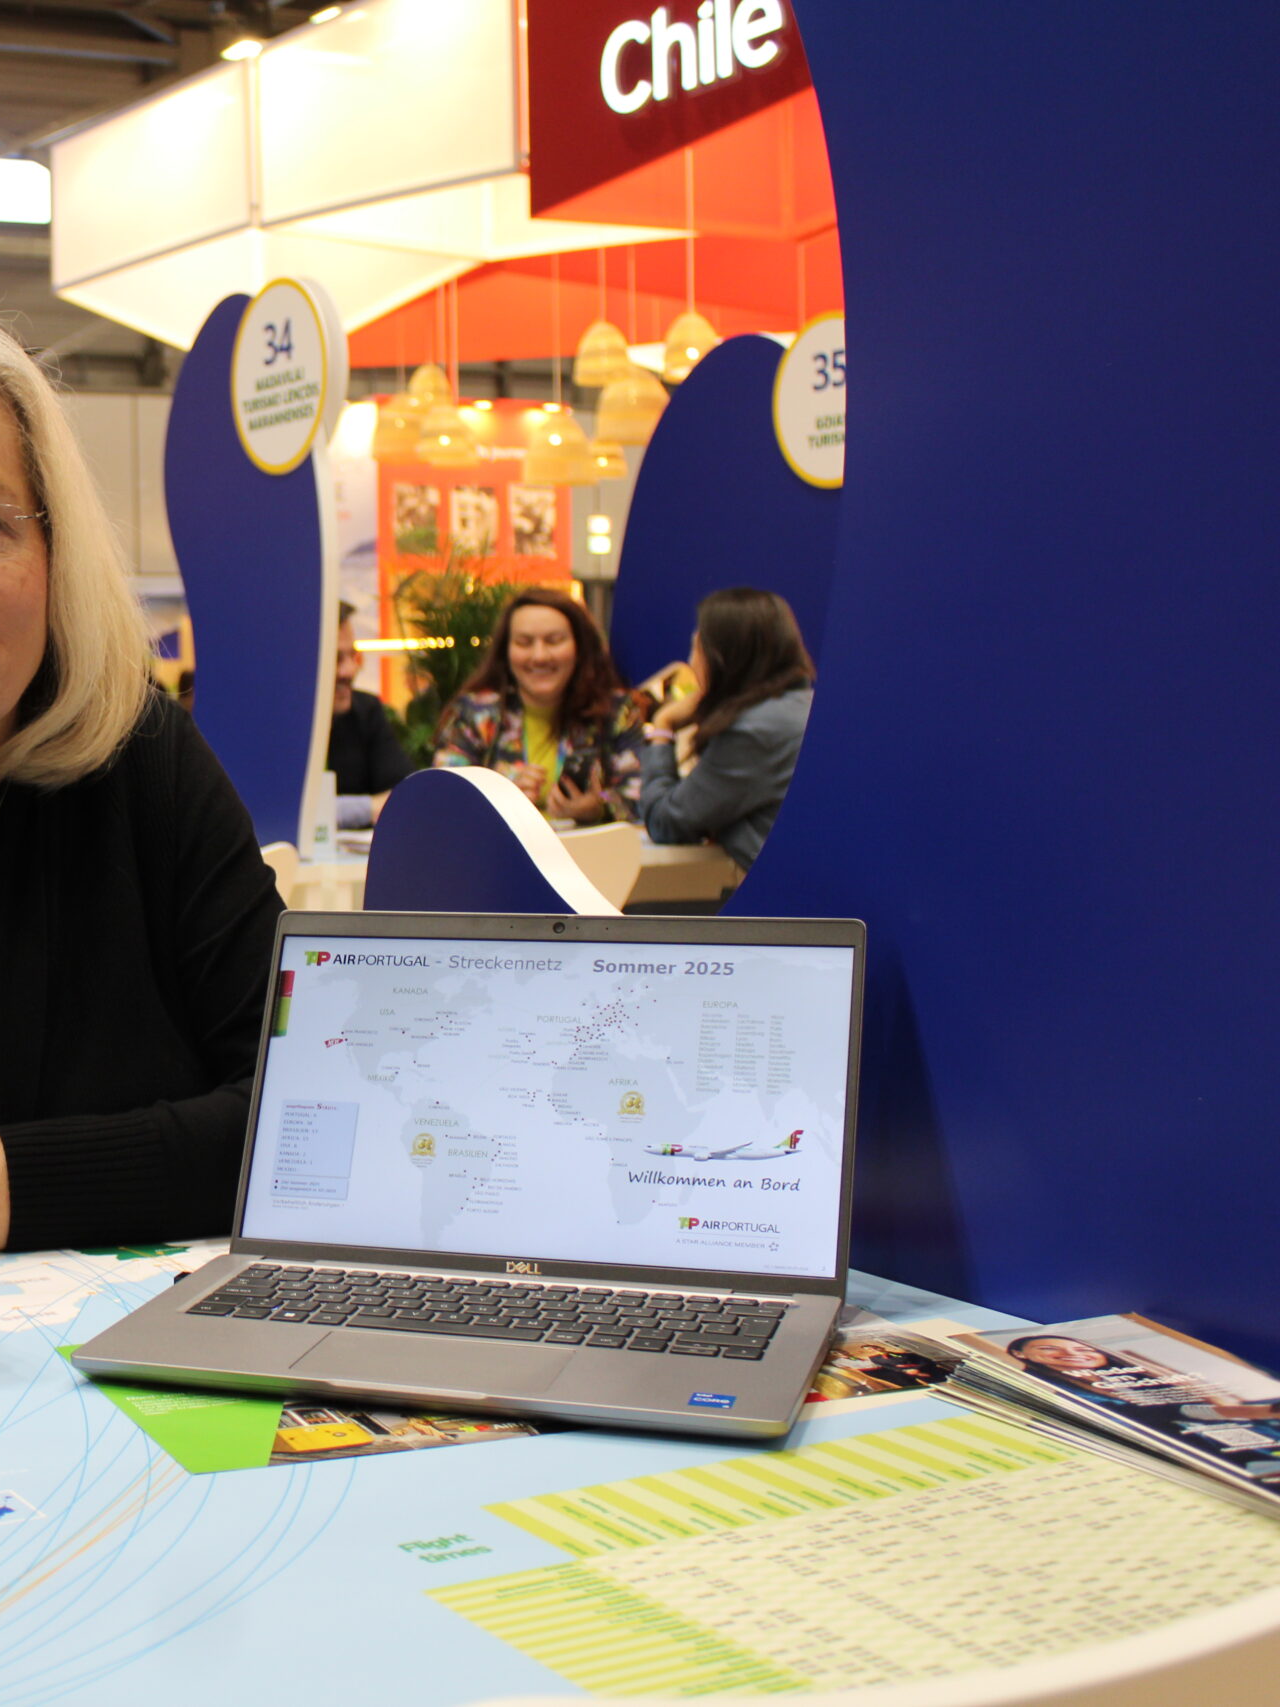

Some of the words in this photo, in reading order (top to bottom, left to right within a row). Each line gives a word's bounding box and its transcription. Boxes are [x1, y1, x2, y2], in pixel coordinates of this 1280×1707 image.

[600, 0, 784, 114] Chile
[263, 317, 293, 367] 34
[812, 350, 846, 391] 35
[448, 955, 563, 972] Streckennetz
[593, 959, 677, 975] Sommer
[684, 961, 735, 976] 2025
[628, 1171, 726, 1188] Willkommen
[733, 1179, 753, 1189] an
[760, 1178, 801, 1191] Bord
[506, 1261, 542, 1275] DELL
